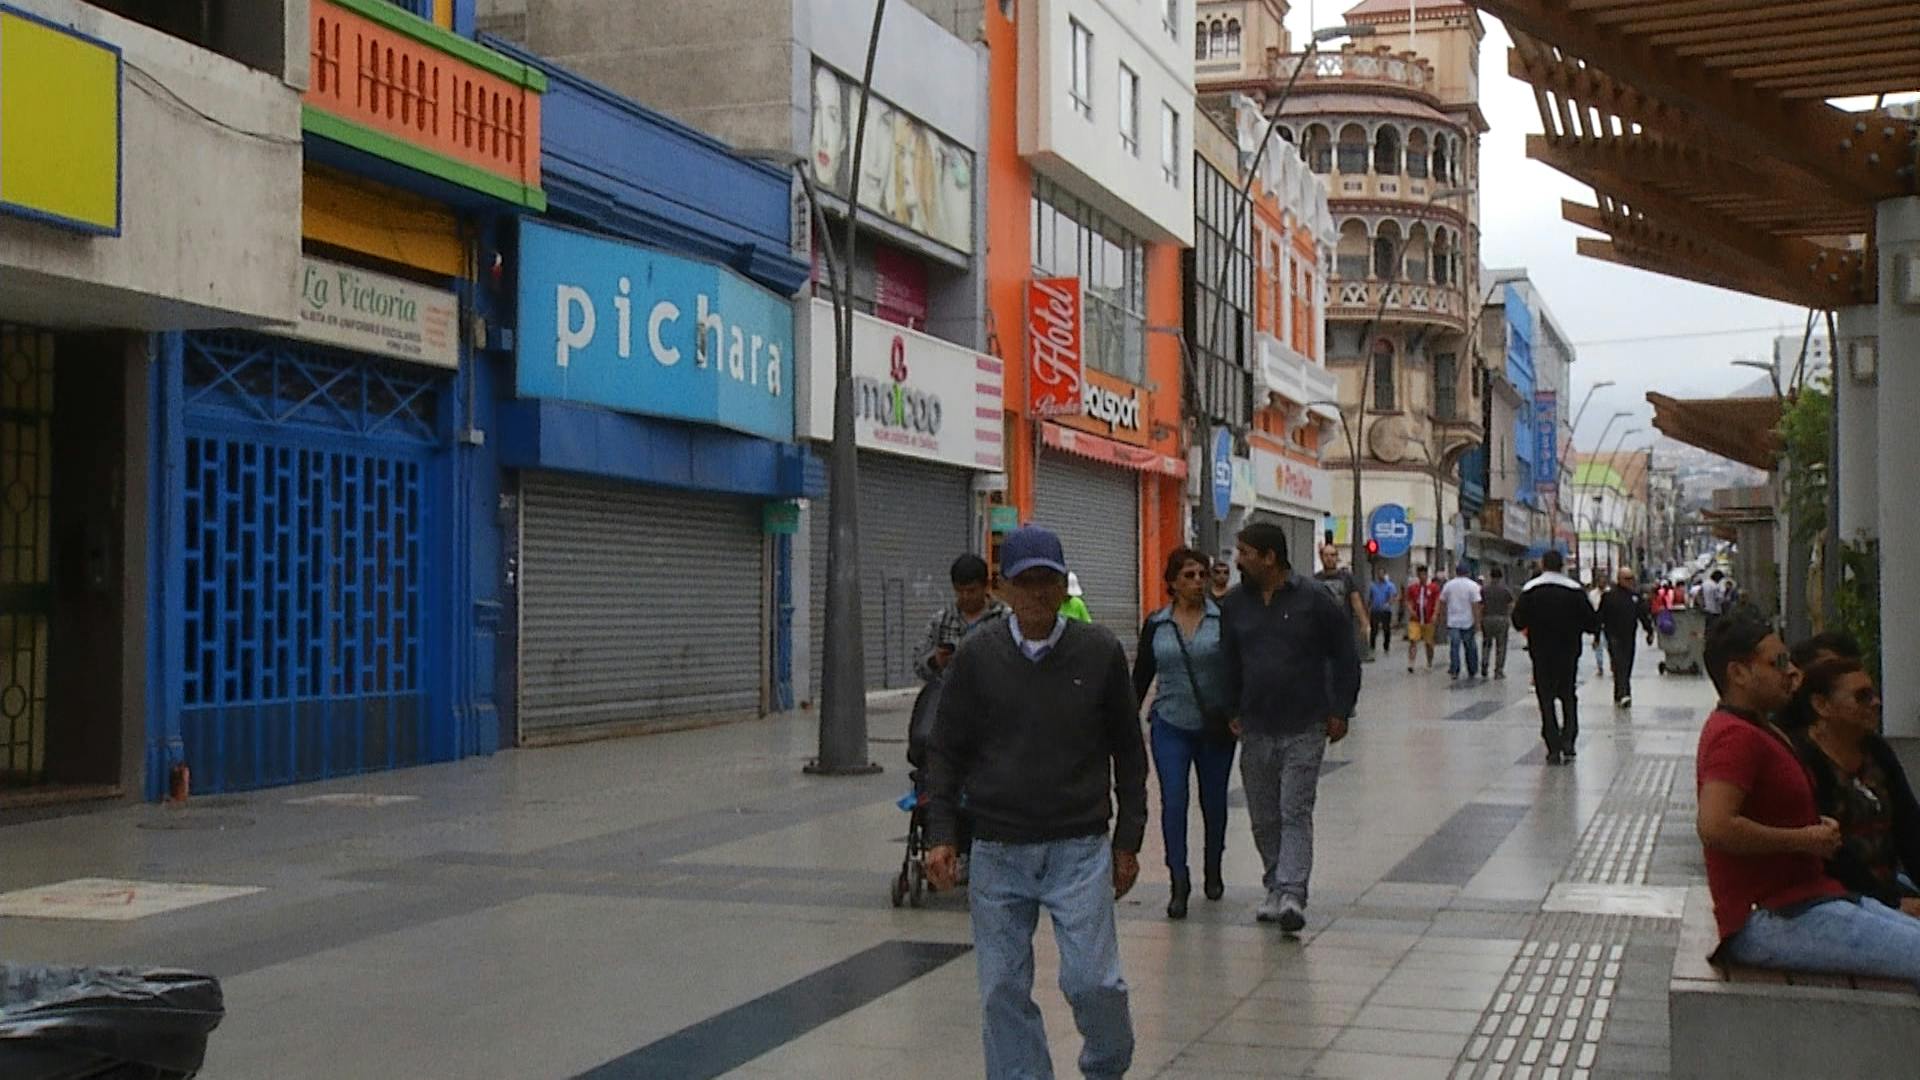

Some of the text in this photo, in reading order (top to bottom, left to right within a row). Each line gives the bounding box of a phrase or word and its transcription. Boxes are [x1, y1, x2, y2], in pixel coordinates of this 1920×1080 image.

[302, 264, 417, 322] La Victoria
[556, 277, 783, 397] pichara
[1029, 280, 1079, 393] Hotel
[1375, 518, 1408, 538] sb
